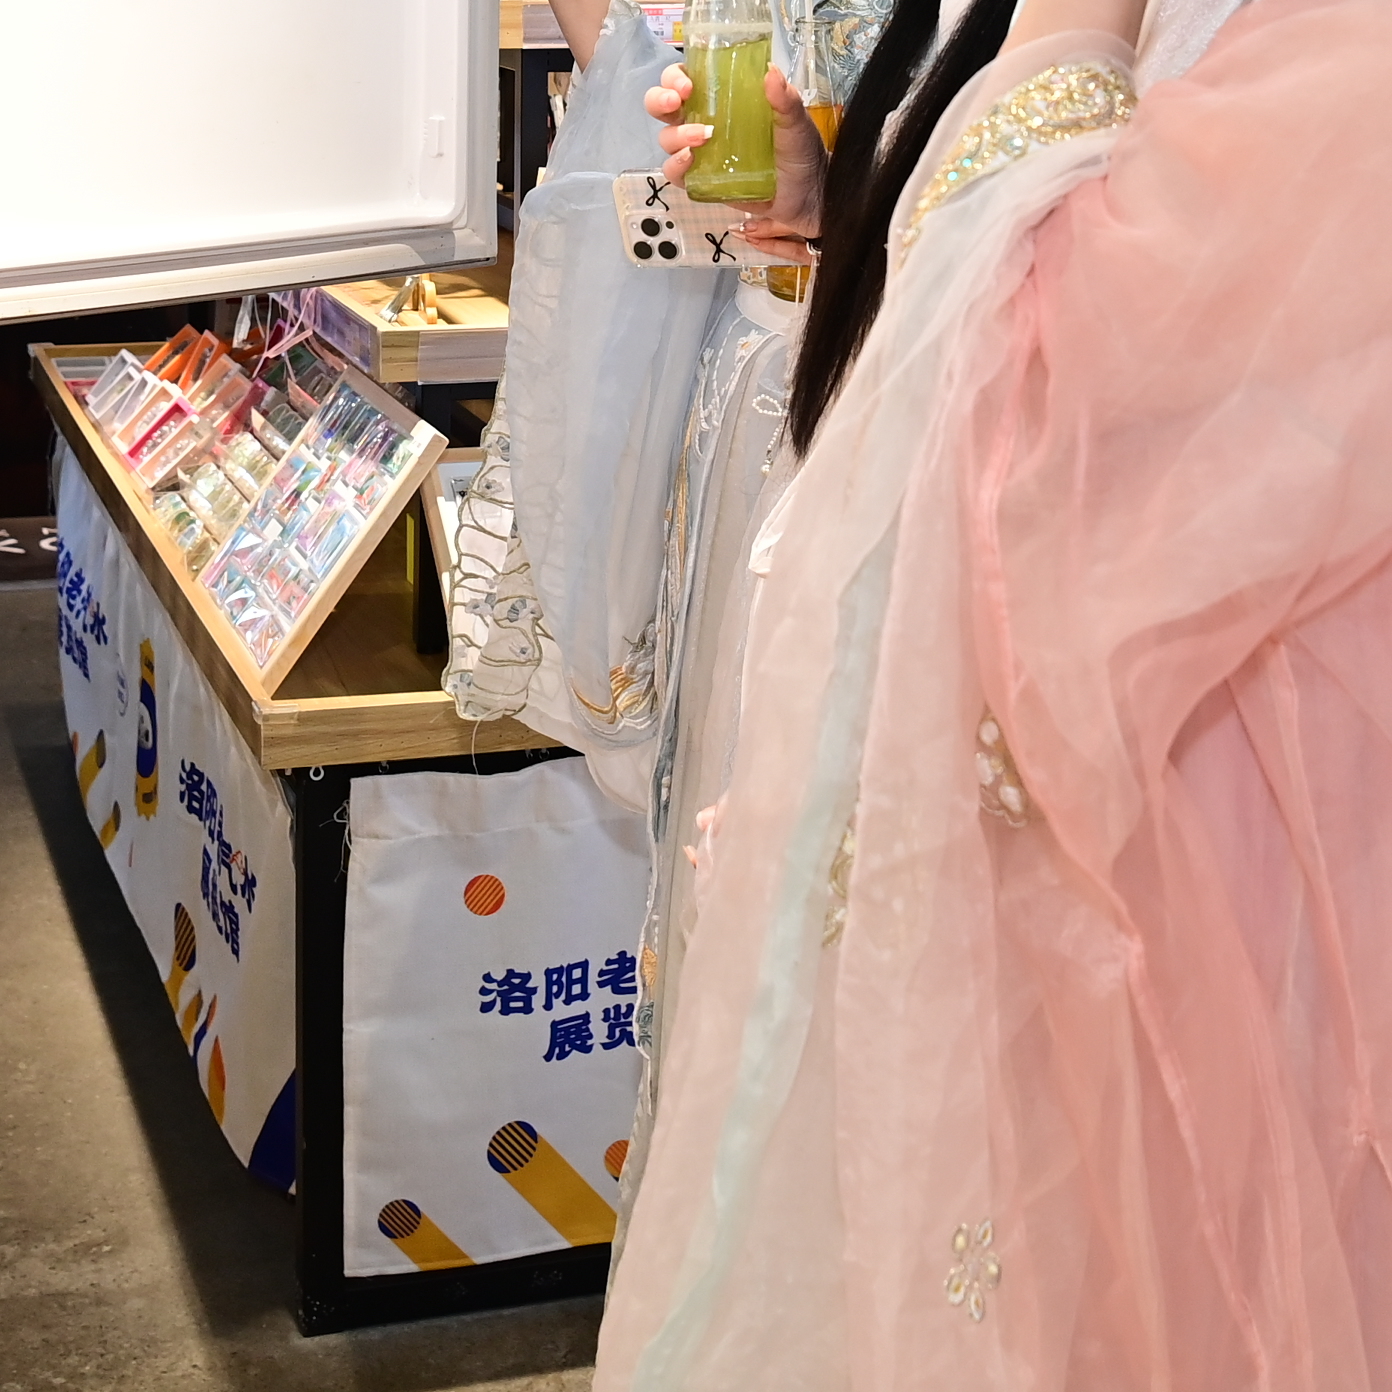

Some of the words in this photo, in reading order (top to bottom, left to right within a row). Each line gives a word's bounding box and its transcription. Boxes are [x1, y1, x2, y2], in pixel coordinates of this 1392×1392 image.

[478, 950, 638, 1016] 洛阳老
[543, 1002, 636, 1062] 展览
